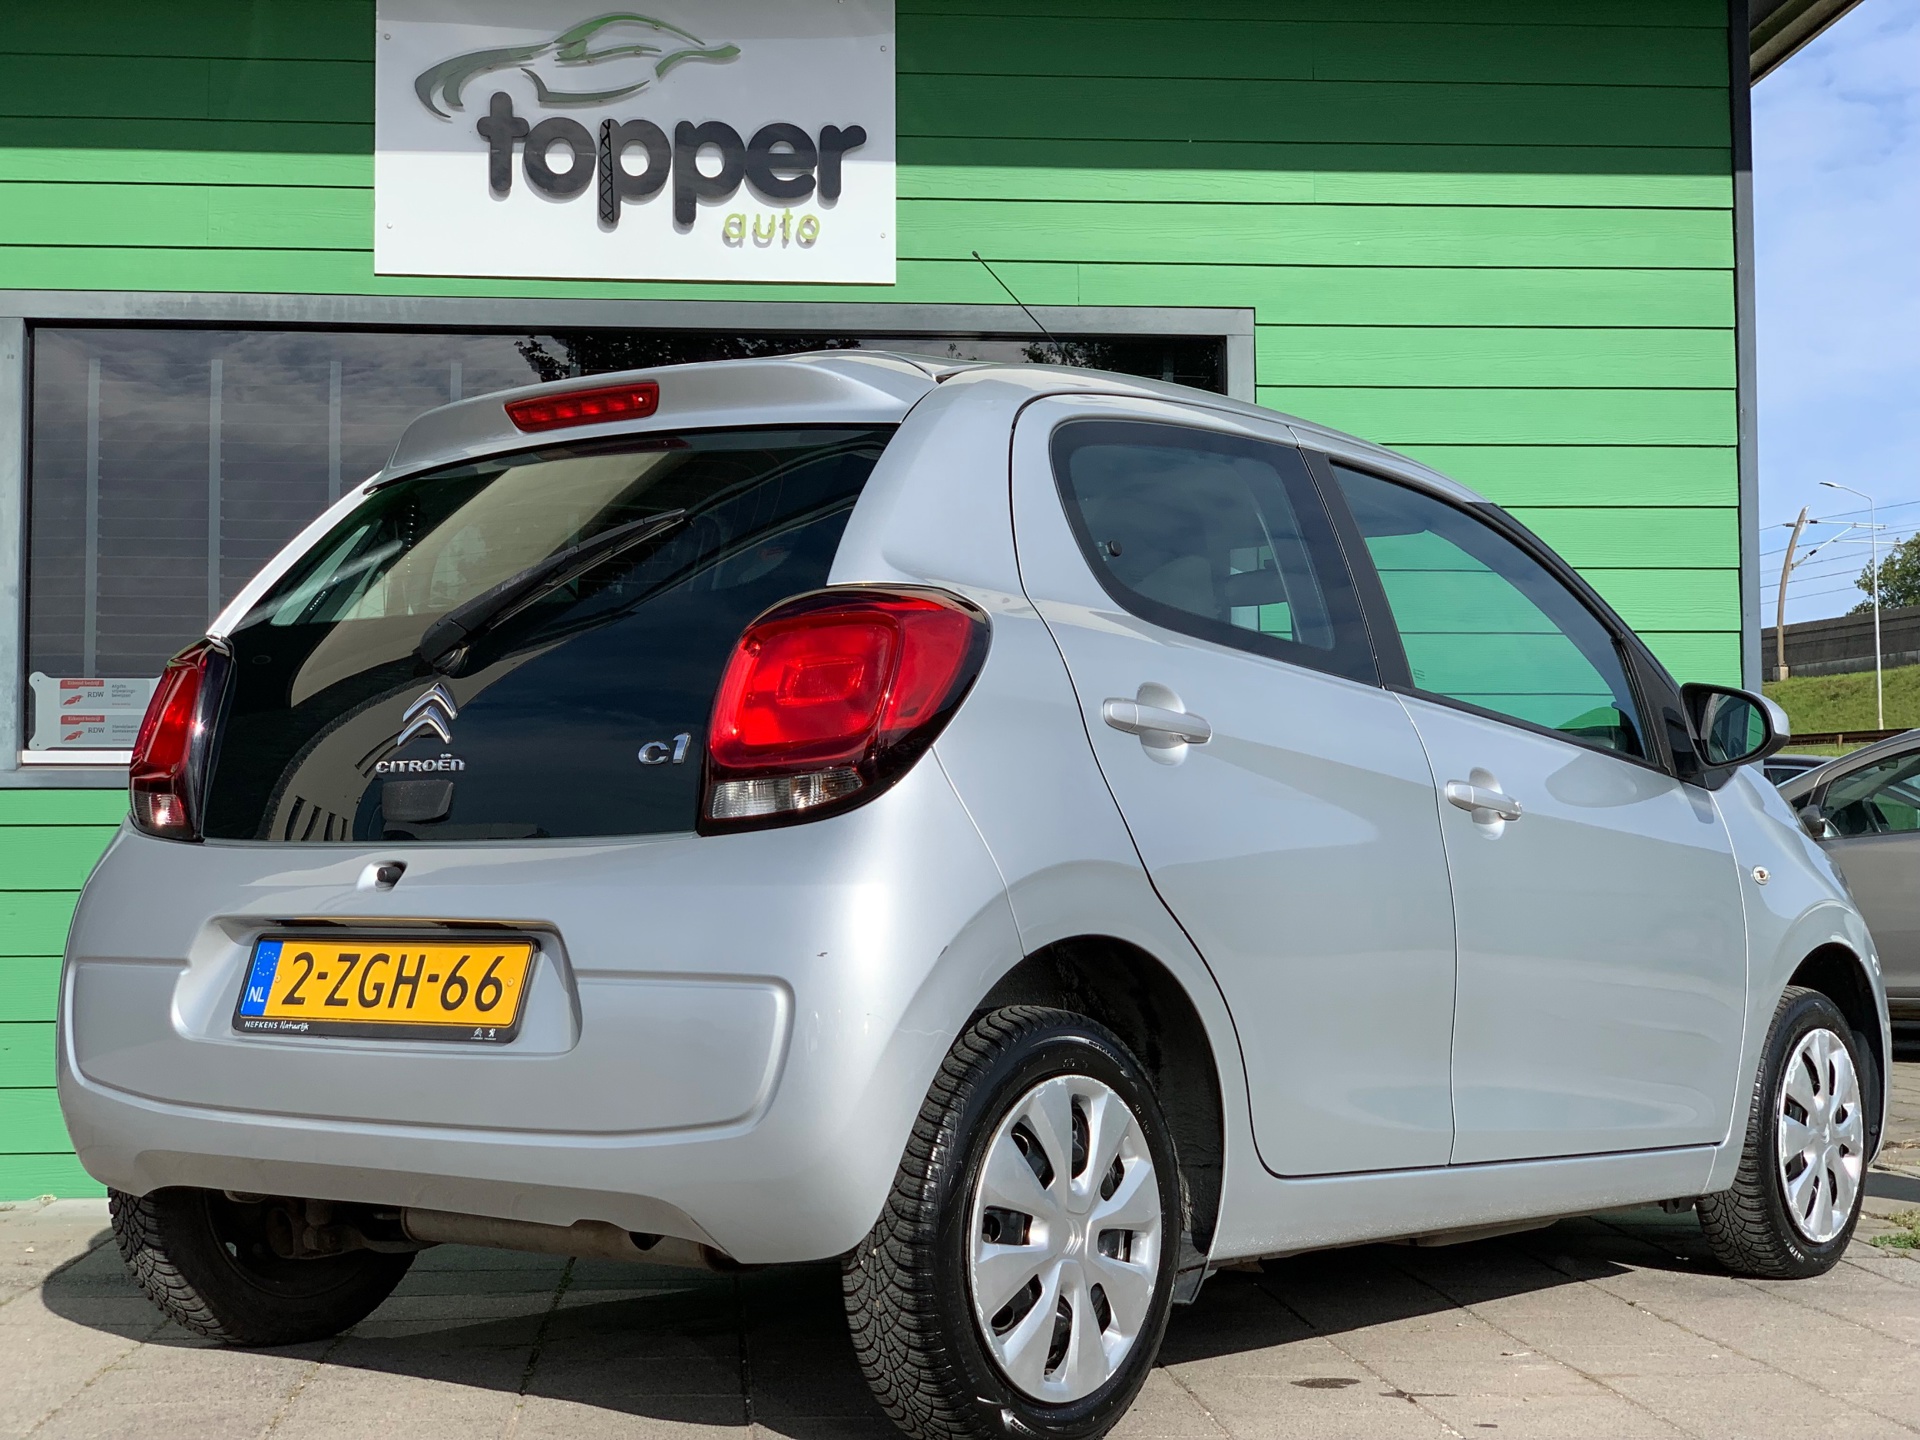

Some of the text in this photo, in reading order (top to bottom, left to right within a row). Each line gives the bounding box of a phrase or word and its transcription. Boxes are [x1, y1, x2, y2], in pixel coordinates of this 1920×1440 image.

[476, 91, 867, 225] topper
[724, 208, 821, 241] auto
[375, 753, 465, 774] CITROËN
[637, 732, 691, 765] C1
[248, 986, 265, 1003] NL
[281, 951, 505, 1013] 2-ZGH-66
[244, 1020, 279, 1029] NEFKENS
